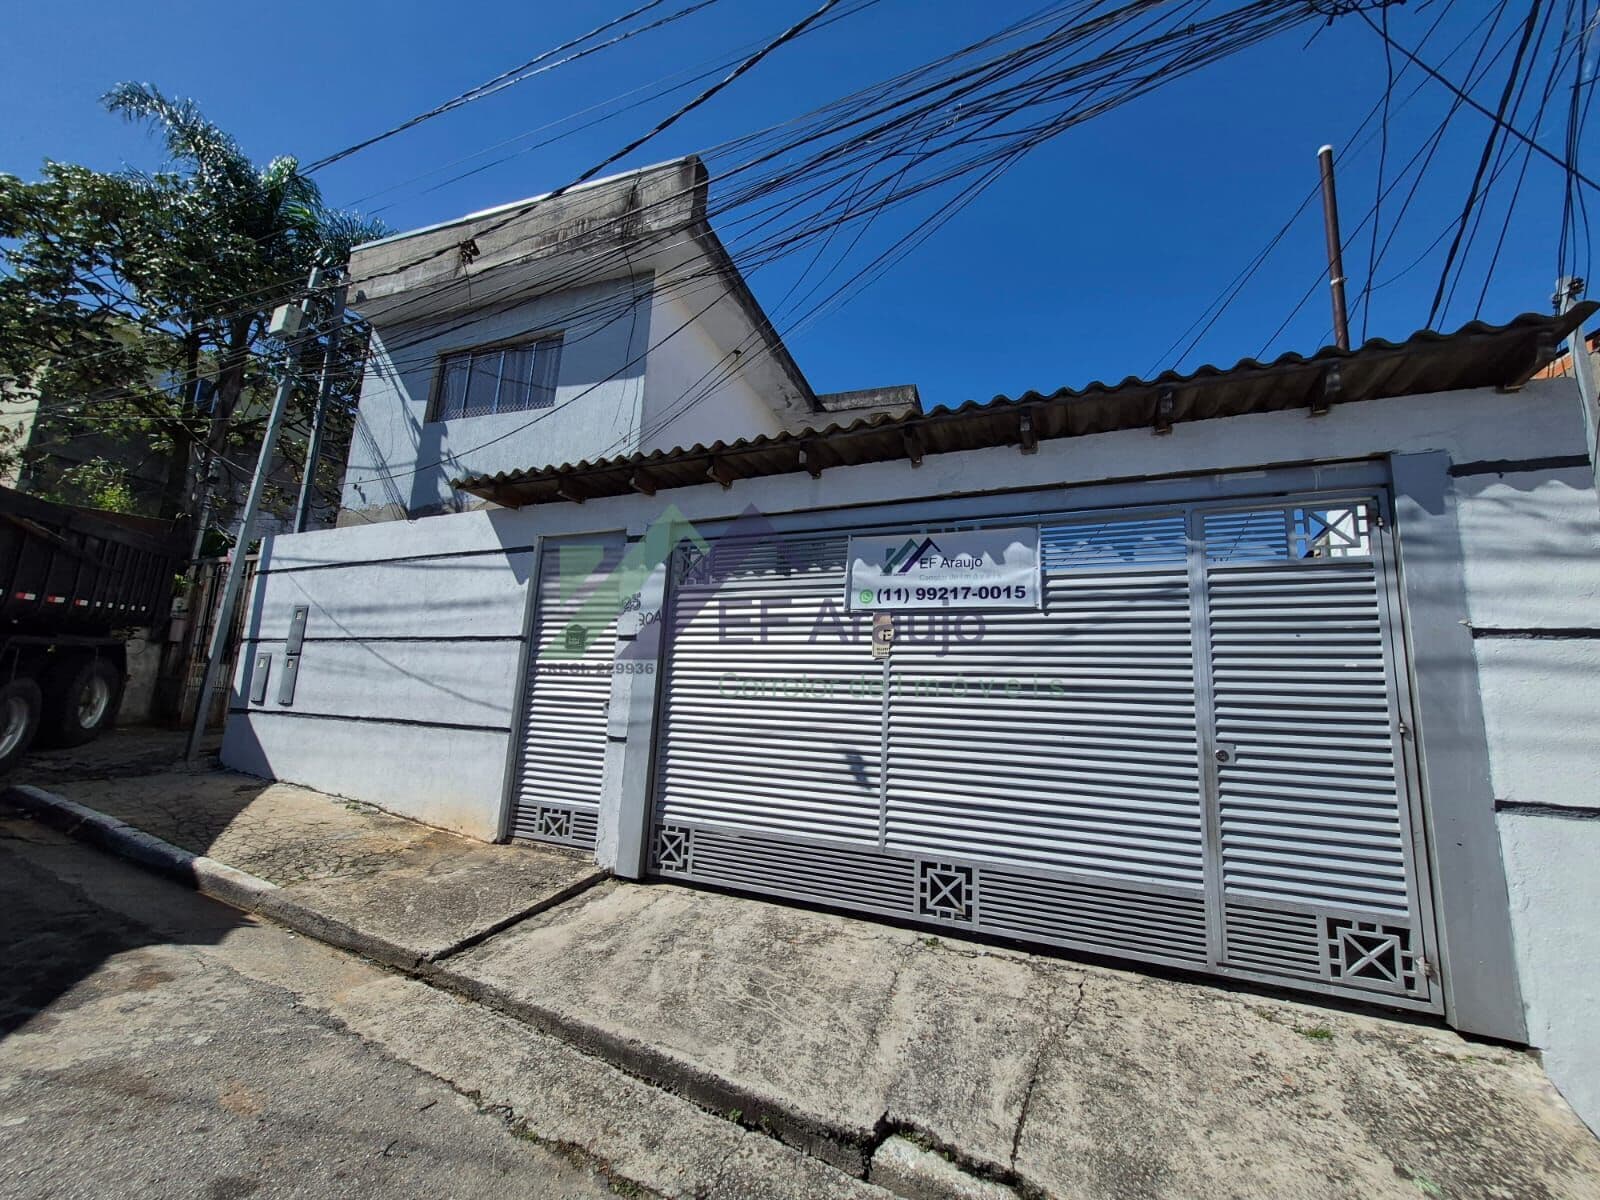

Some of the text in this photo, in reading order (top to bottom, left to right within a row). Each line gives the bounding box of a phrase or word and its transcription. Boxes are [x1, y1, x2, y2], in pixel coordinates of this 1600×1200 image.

[919, 556, 984, 570] EF Araujo
[877, 586, 1026, 604] (11) 99217-0015
